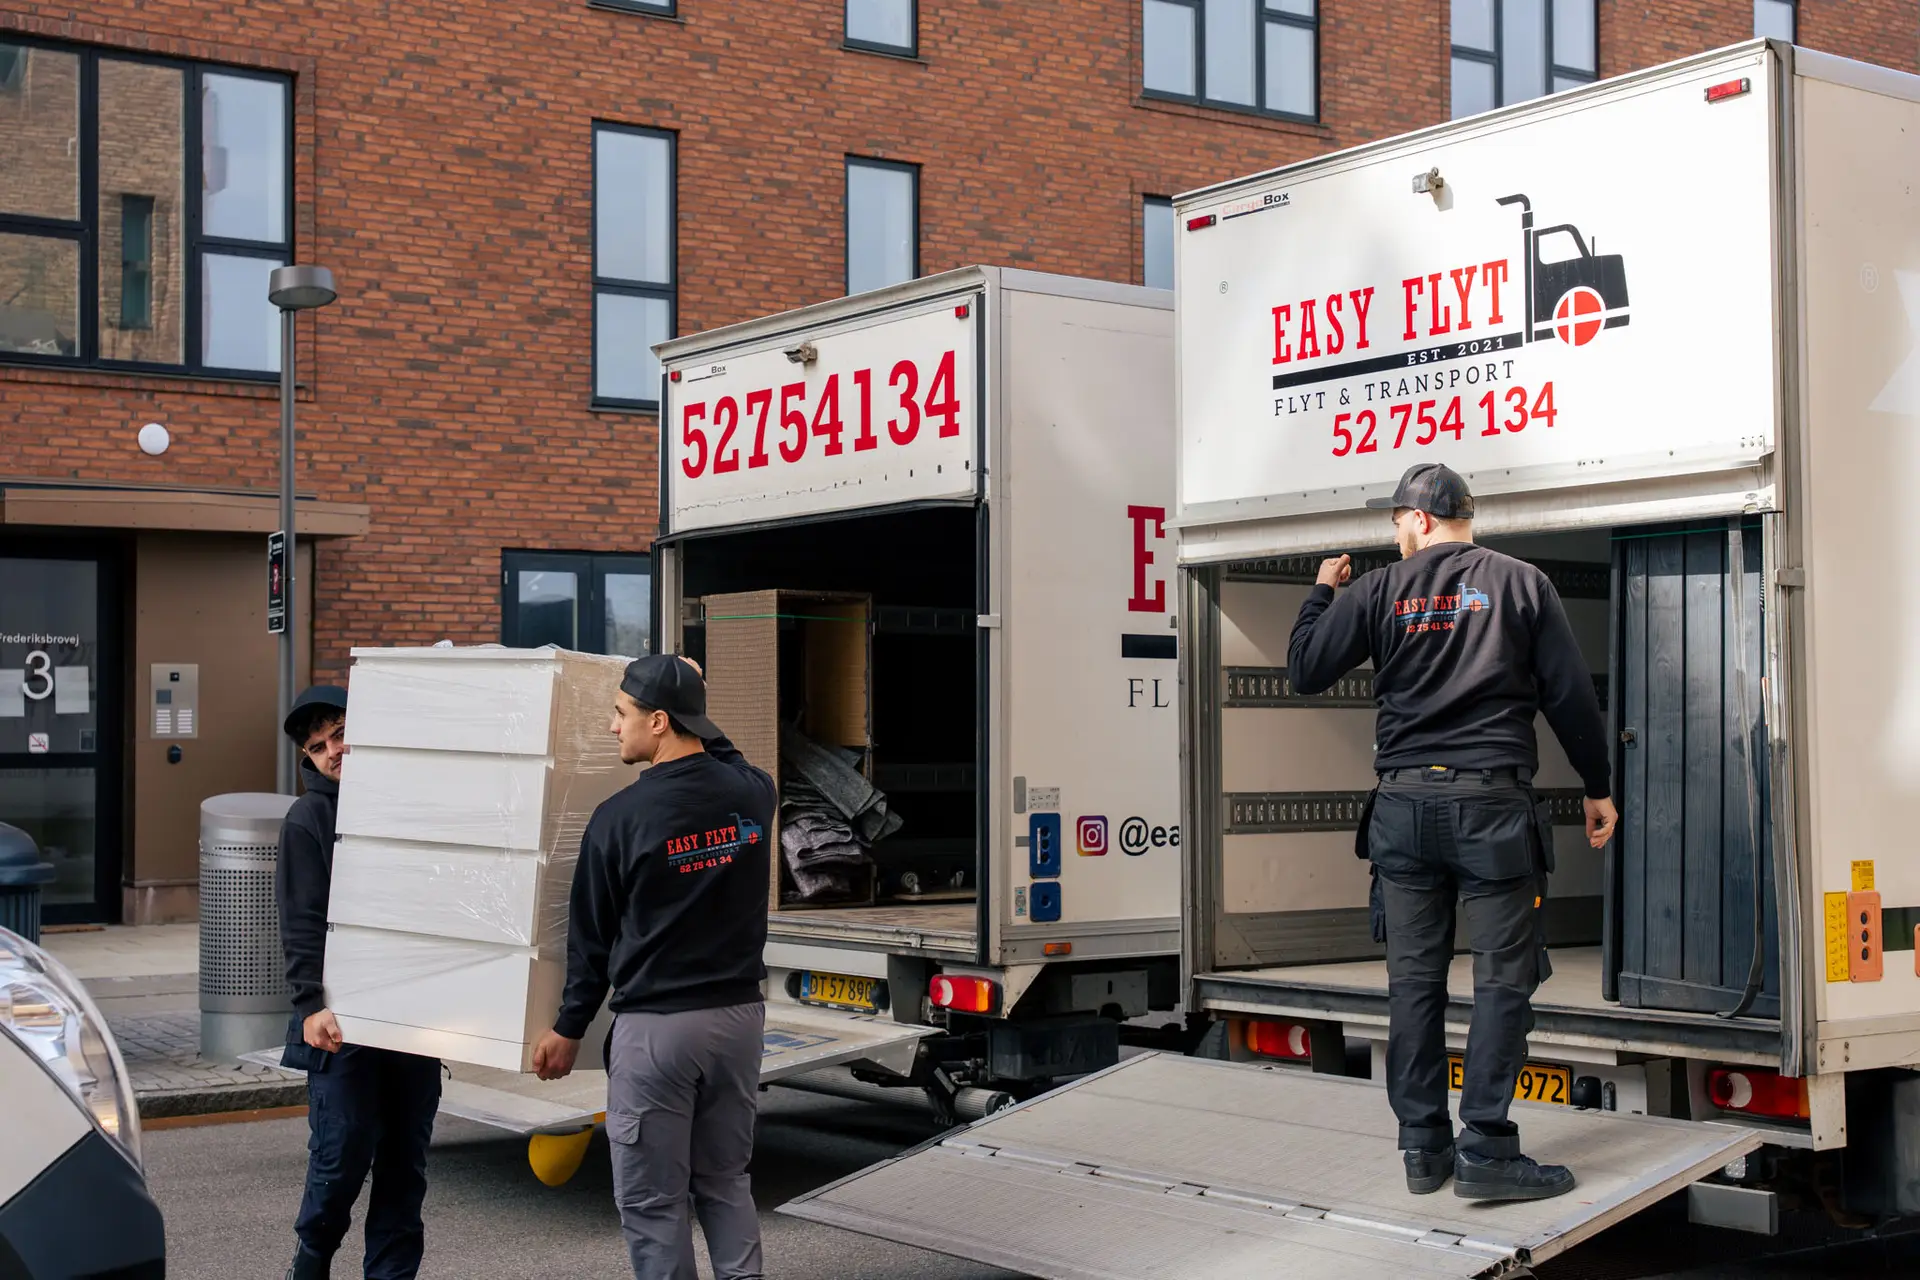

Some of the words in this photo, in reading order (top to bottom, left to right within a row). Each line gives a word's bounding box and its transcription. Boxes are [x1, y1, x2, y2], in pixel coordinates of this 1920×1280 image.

[1272, 287, 1375, 365] EASY
[1402, 258, 1508, 342] FLYT
[1407, 349, 1447, 366] EST.
[1457, 337, 1505, 356] 2021
[711, 365, 727, 375] Box
[1274, 391, 1326, 417] FLYT
[1339, 387, 1350, 406] &
[1364, 359, 1514, 401] TRANSPORT
[681, 349, 960, 479] 52754134
[1331, 408, 1378, 457] 52
[1389, 395, 1465, 449] 754
[1478, 380, 1558, 437] 134
[1395, 598, 1427, 615] EASY
[1433, 594, 1461, 610] FLYT
[1430, 622, 1441, 630] 41
[1443, 621, 1455, 629] 34
[22, 650, 53, 699] 3
[667, 833, 698, 855] EASY
[705, 825, 737, 846] FLYT
[680, 863, 692, 873] 52
[693, 861, 704, 871] 75
[705, 858, 717, 868] 41
[720, 855, 732, 864] 34
